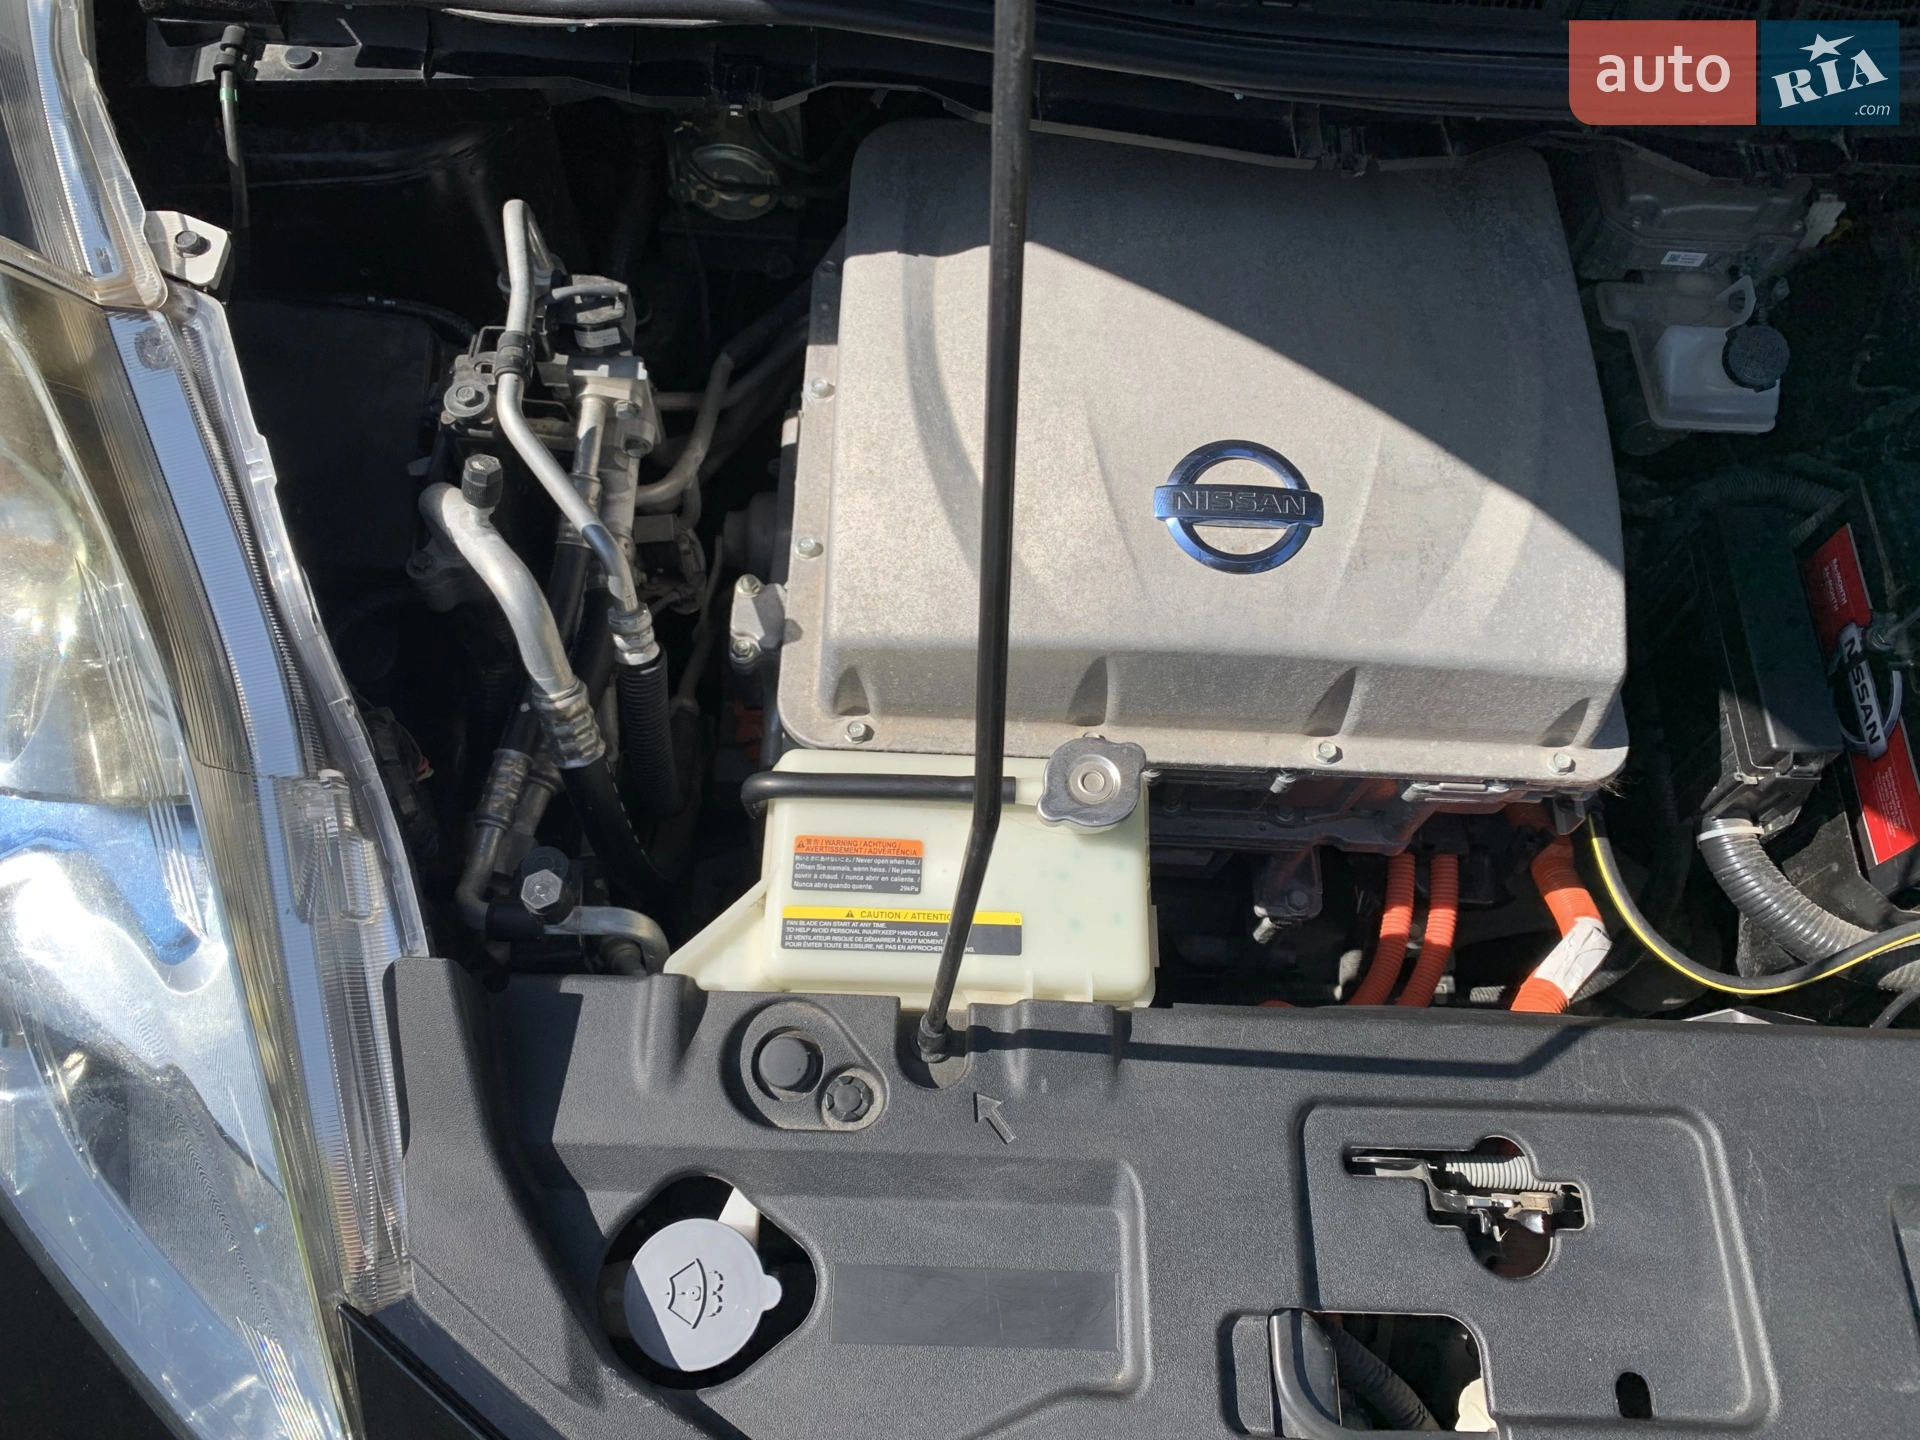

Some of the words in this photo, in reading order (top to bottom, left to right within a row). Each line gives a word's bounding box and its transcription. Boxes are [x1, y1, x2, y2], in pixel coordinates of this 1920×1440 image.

[1172, 490, 1306, 515] NISSAN
[1844, 636, 1880, 745] NSSAN
[825, 839, 859, 847] WARNING
[805, 846, 863, 854] AVERTISSEMENT
[901, 867, 920, 875] jamais
[860, 911, 901, 919] CAUTION
